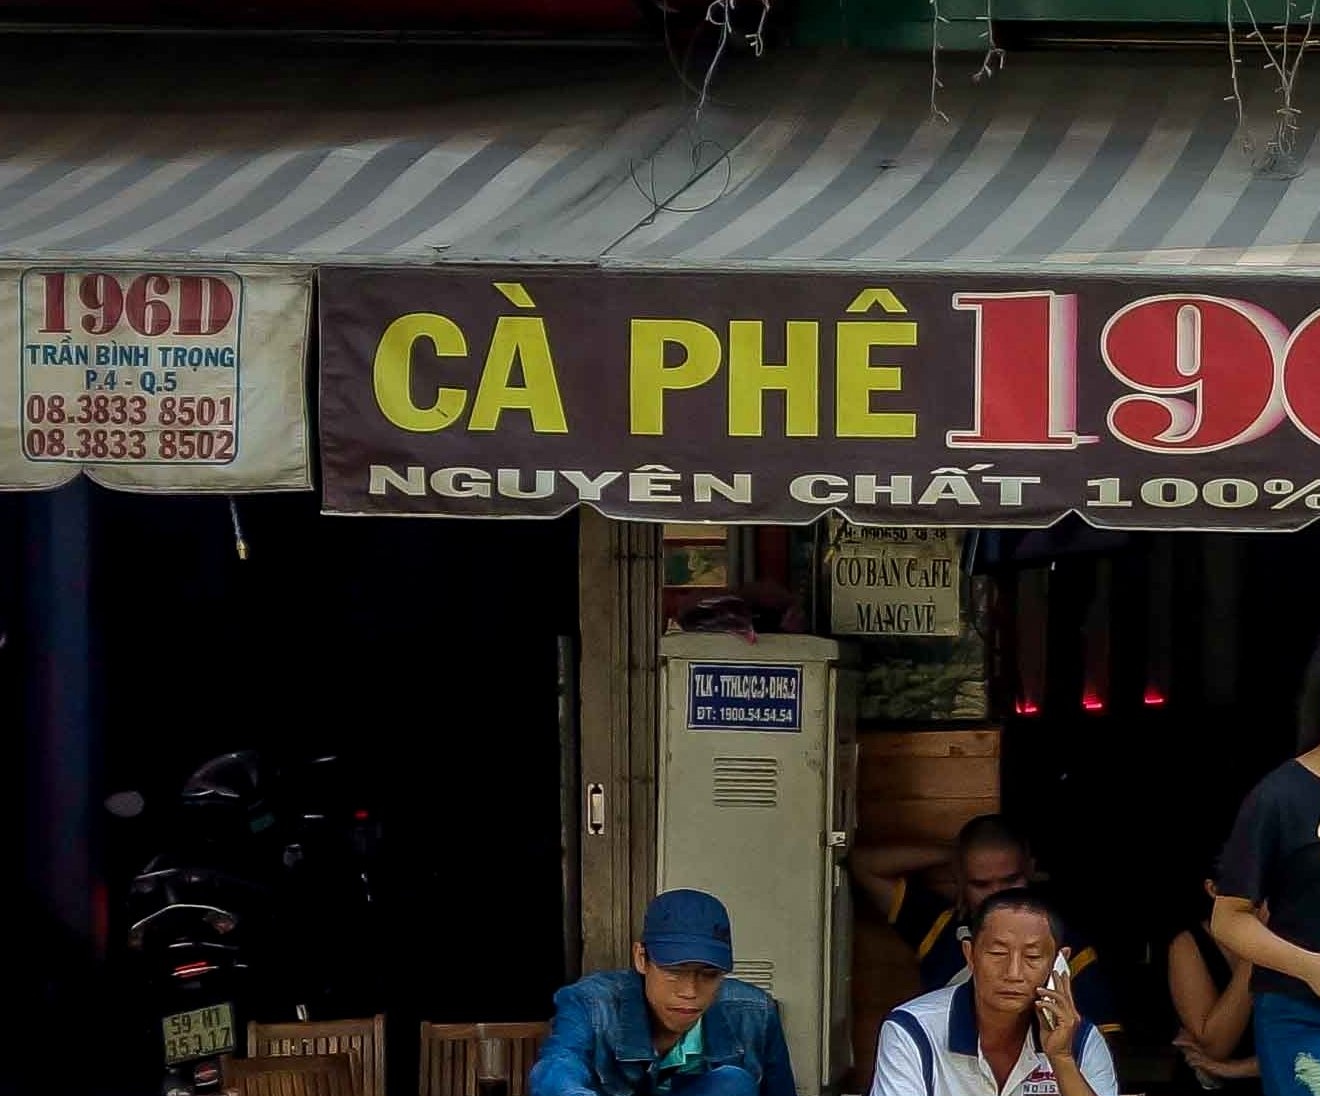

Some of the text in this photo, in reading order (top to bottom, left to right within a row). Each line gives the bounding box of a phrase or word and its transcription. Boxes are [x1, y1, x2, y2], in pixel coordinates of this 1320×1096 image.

[38, 272, 234, 337] 196D
[26, 336, 235, 373] TRẦN BÌNH TRỌNG
[373, 282, 569, 434] CÀ
[629, 288, 918, 438] PHÊ
[85, 369, 117, 391] P.4
[139, 371, 177, 395] Q.5
[26, 395, 234, 426] 08.3833 8501
[26, 428, 234, 459] 08.3833 8502
[368, 463, 753, 502] NGUYÊN
[787, 462, 1041, 508] CHẤT
